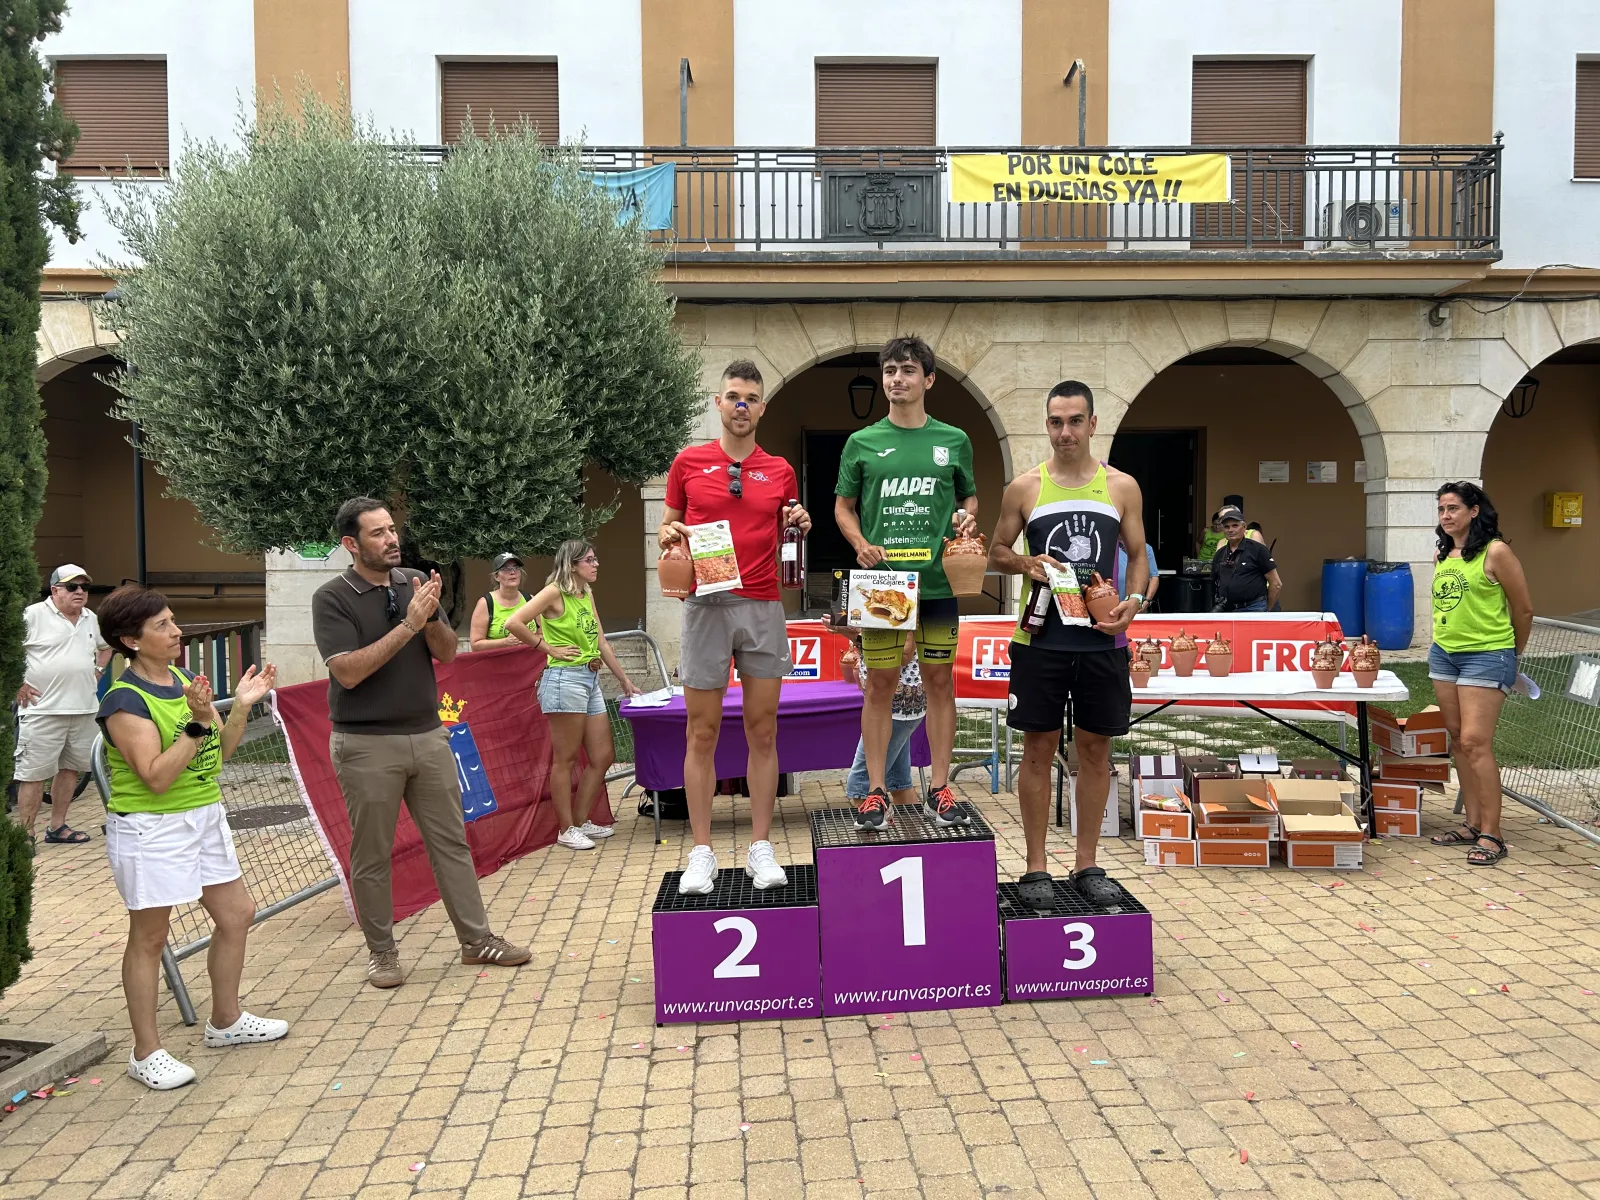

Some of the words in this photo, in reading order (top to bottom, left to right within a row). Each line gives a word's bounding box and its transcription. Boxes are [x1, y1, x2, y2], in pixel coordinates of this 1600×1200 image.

[1008, 154, 1053, 176] POR
[1059, 155, 1090, 175] UN
[1097, 154, 1158, 176] COLE
[993, 182, 1022, 202] EN
[1028, 178, 1118, 202] DUEÑAS
[880, 477, 938, 498] MAPEI
[872, 579, 906, 587] cascajares
[879, 573, 898, 581] lechal
[841, 579, 849, 610] cascajares
[790, 639, 817, 665] IZ
[976, 639, 1011, 665] FR
[880, 856, 926, 947] 1
[712, 916, 760, 979] 2
[1062, 922, 1098, 971] 3
[833, 981, 992, 1006] www.runvasport.es
[1014, 975, 1149, 995] www.runvasport.es
[662, 995, 815, 1016] www.runvasport.es
